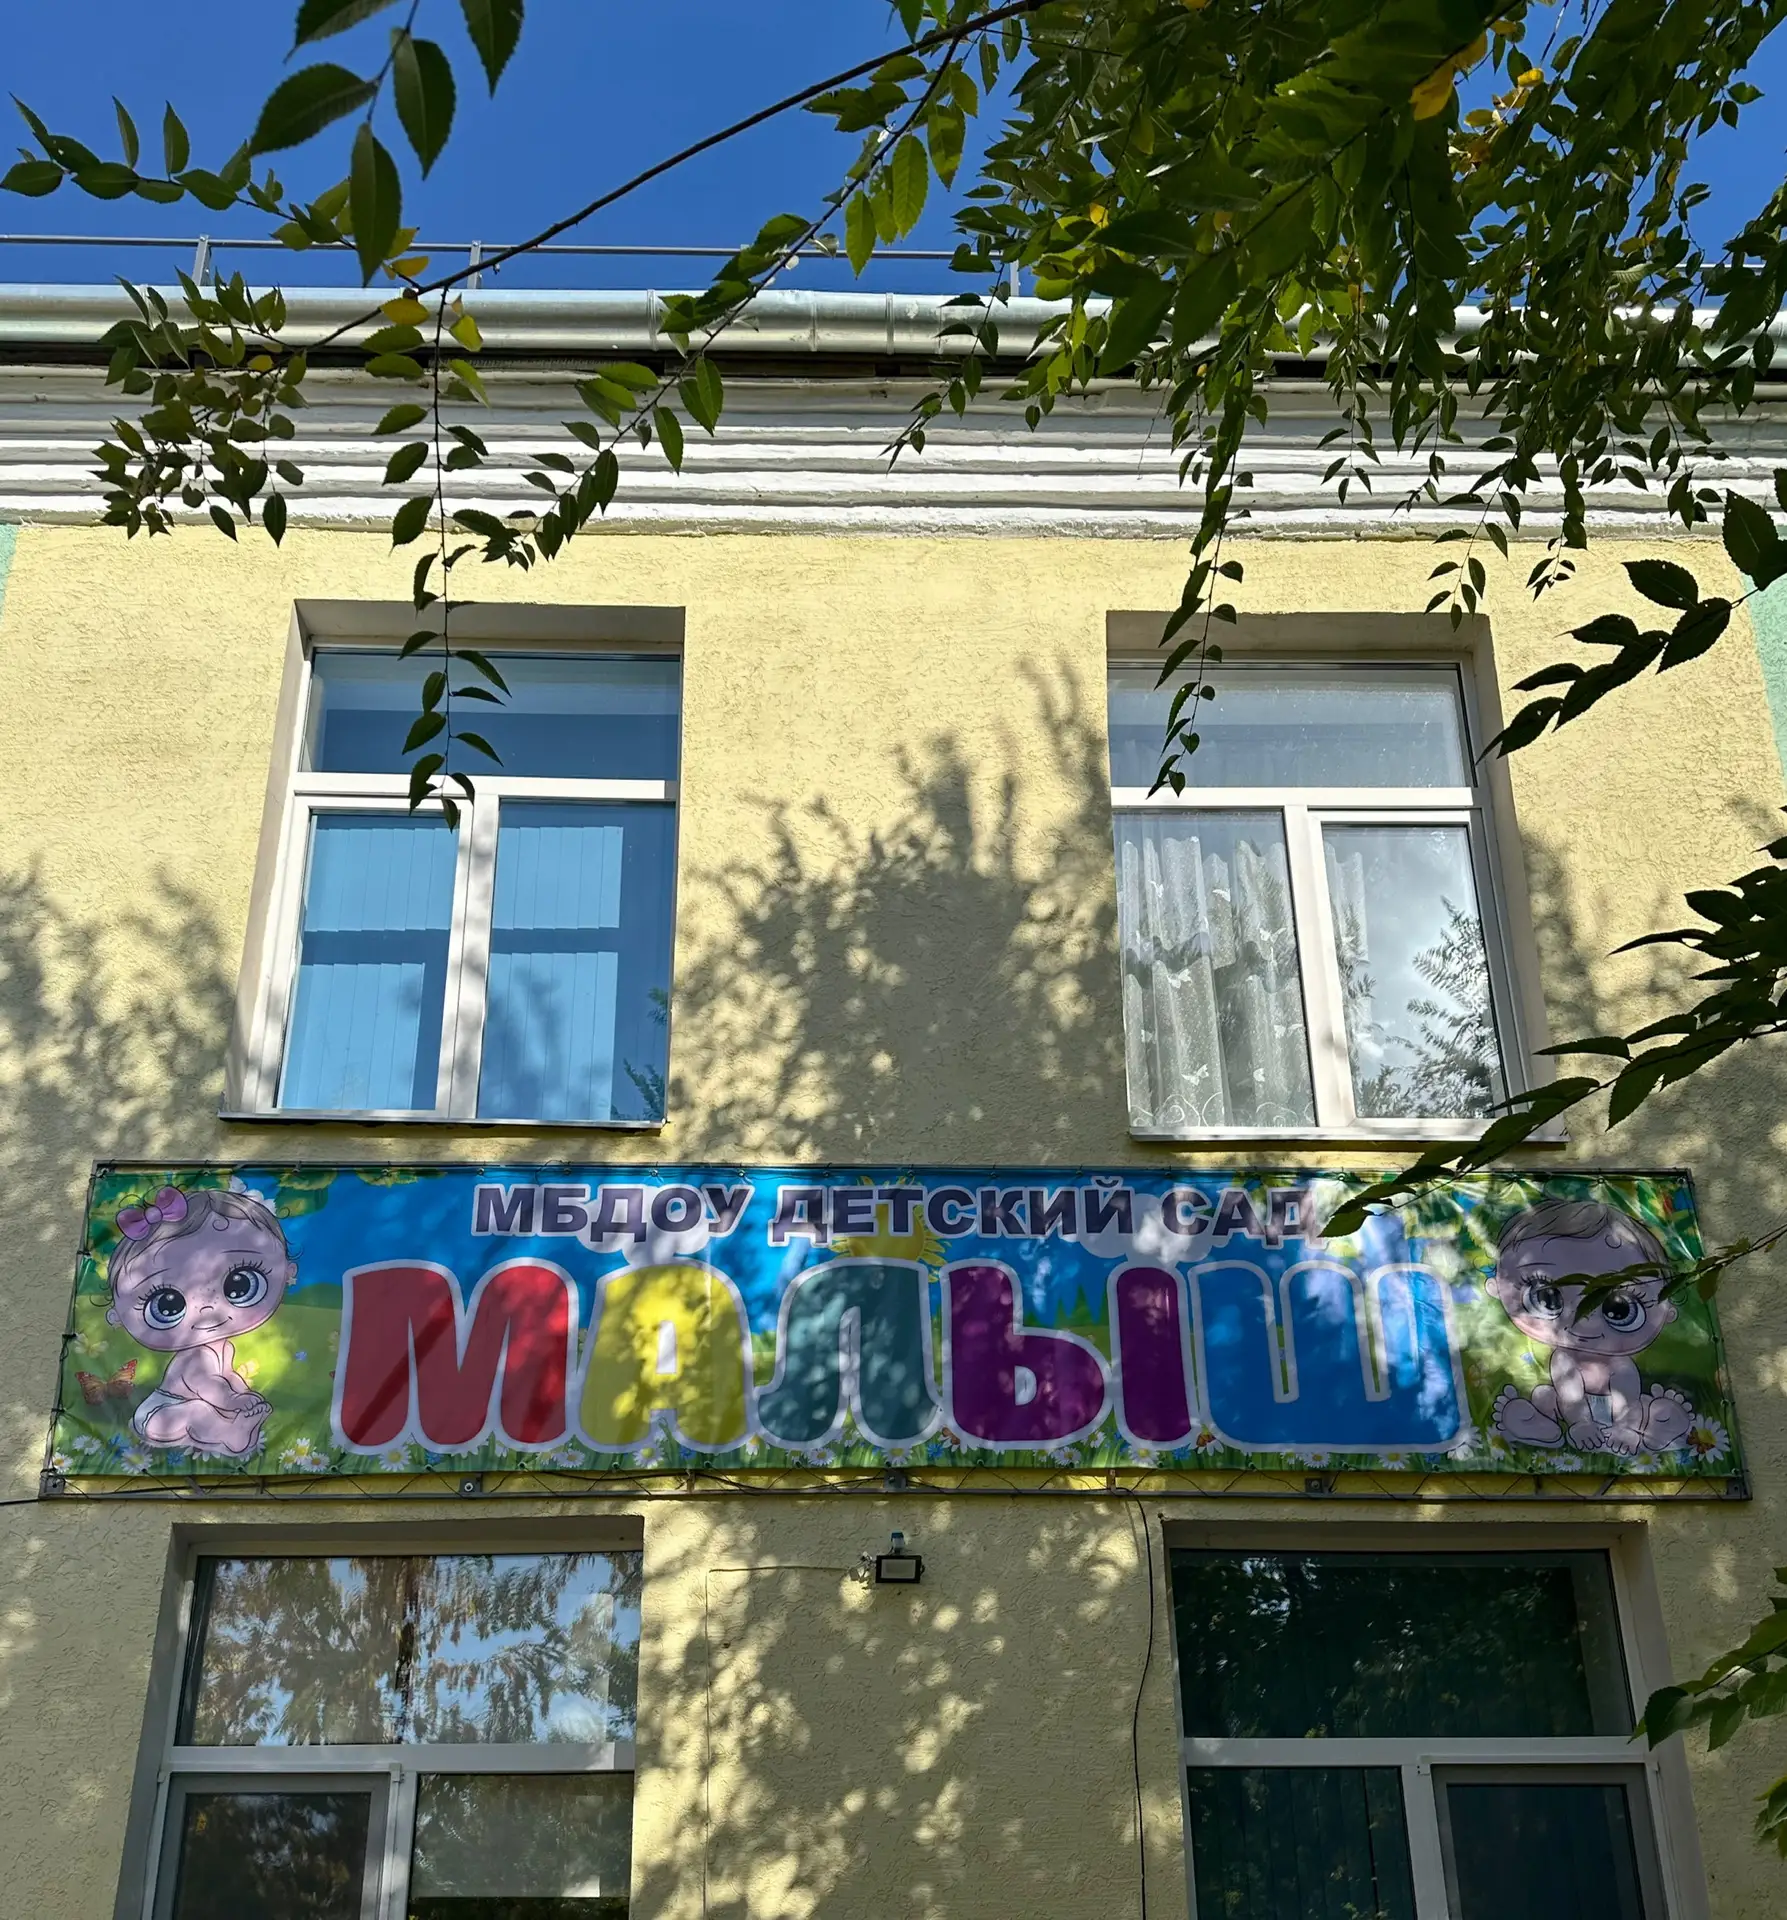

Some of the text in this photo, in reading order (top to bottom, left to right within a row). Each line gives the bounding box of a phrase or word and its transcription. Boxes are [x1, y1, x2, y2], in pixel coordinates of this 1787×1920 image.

[473, 1178, 1318, 1246] МБДОУ ДЕТСКИЙ САД
[334, 1258, 1472, 1454] МАЛЫШ
